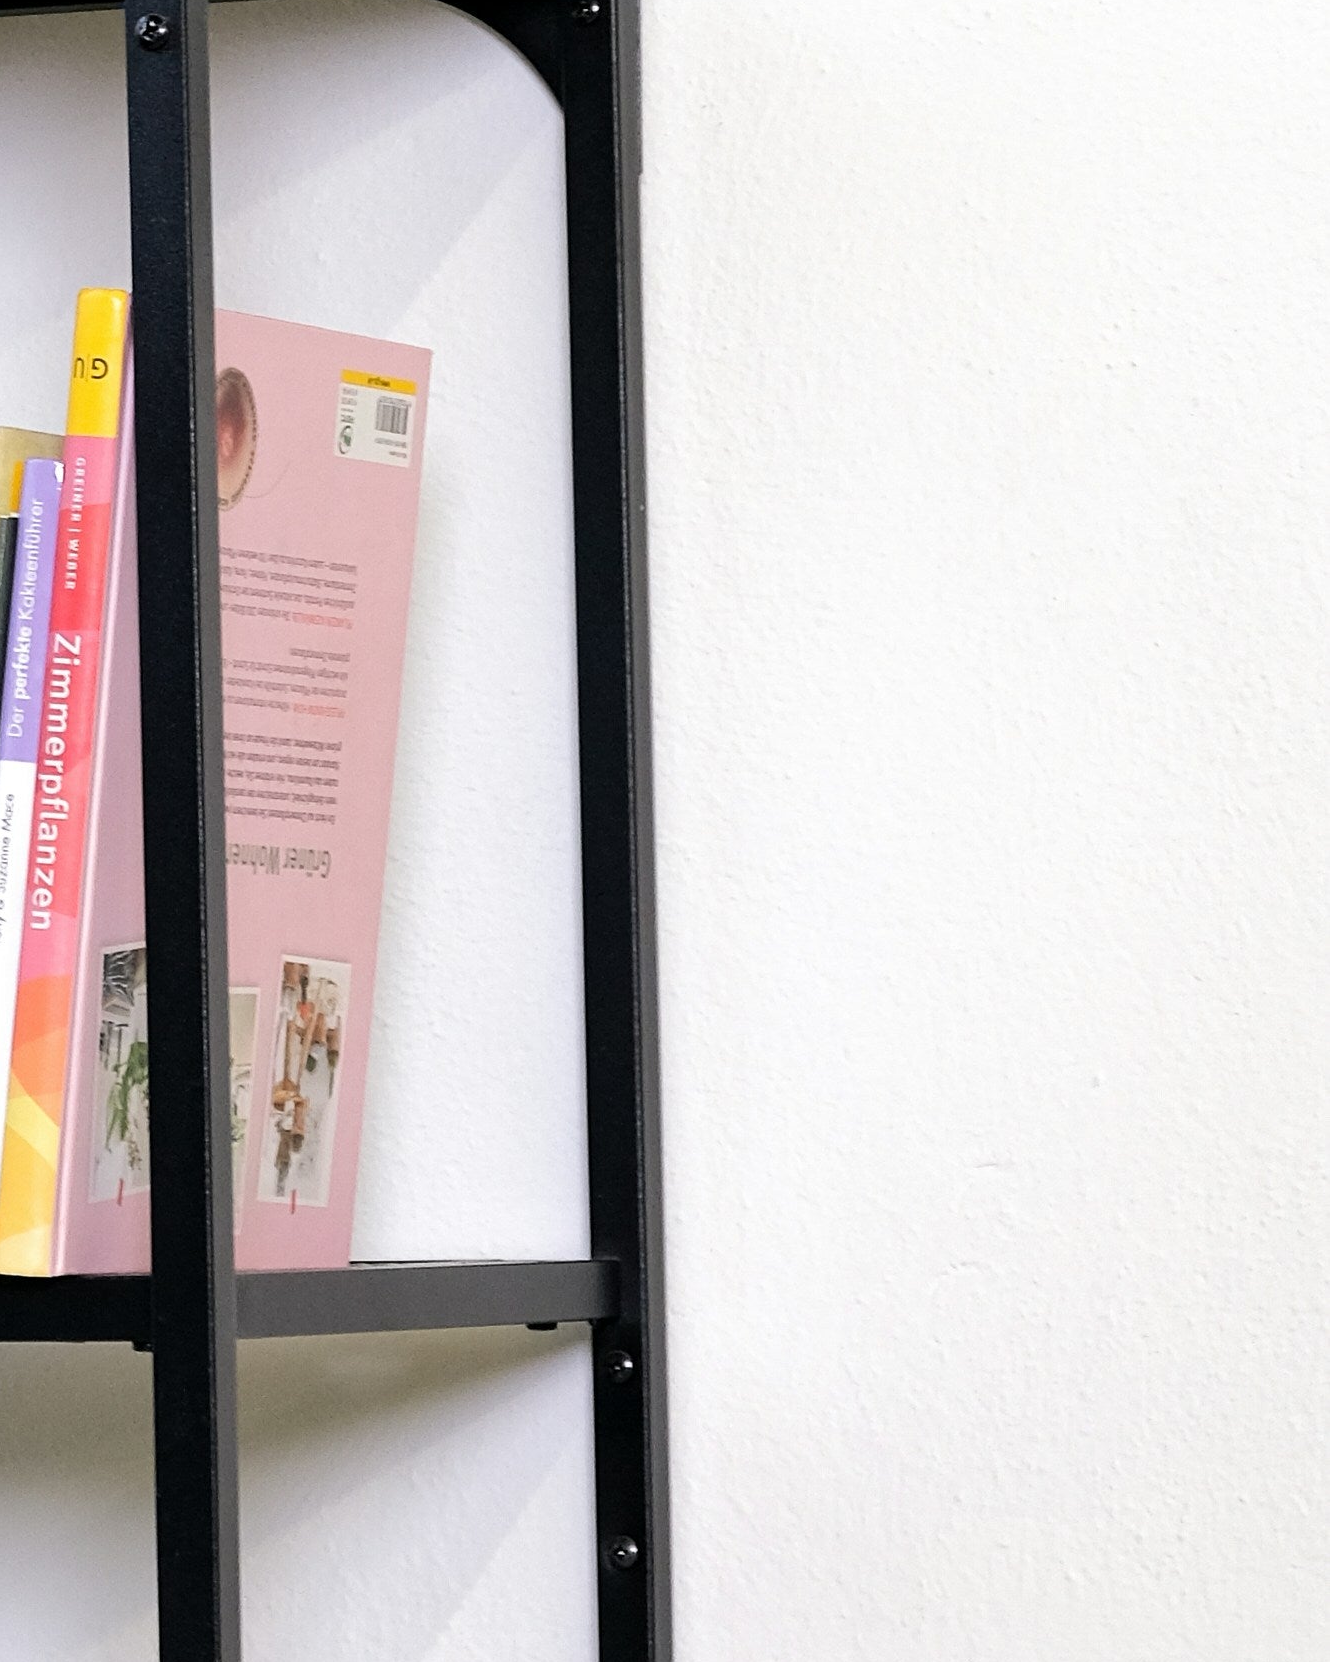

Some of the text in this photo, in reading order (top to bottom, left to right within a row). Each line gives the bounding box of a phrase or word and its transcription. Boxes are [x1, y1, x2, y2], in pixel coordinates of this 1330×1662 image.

[70, 457, 86, 522] GREINER
[64, 538, 80, 591] WEBER
[8, 500, 44, 738] Der perfekte Kakteenführer
[30, 633, 82, 930] Zimmerpflanzen
[0, 794, 15, 832] Mace
[282, 847, 332, 878] Grüner
